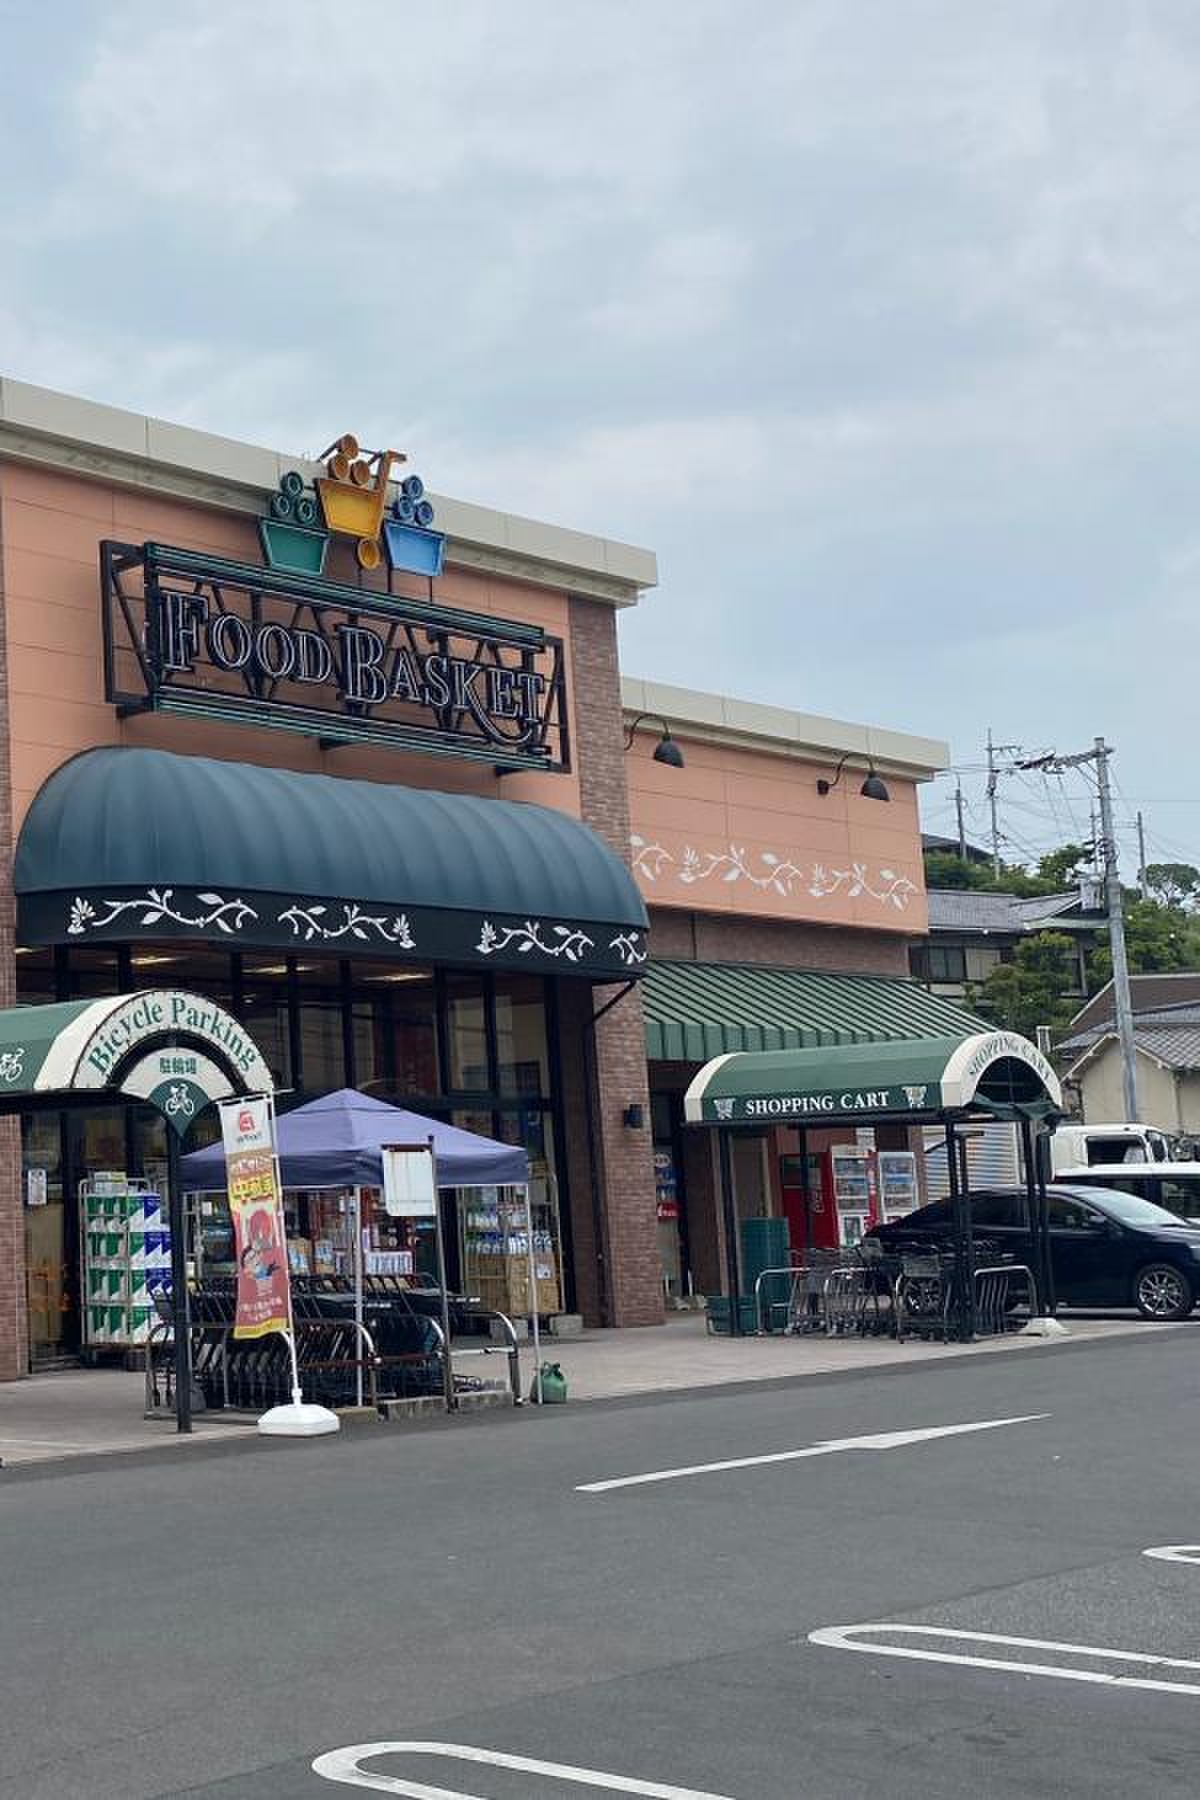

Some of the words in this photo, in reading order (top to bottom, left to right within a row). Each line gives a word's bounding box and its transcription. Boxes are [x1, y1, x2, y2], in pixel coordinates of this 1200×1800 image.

[159, 588, 337, 684] FOOD
[337, 622, 546, 746] BASKET
[88, 998, 163, 1075] Bicycle
[171, 997, 257, 1073] Parking
[159, 1056, 198, 1075] 駐輪場
[745, 1095, 834, 1117] SHOPPING
[840, 1090, 891, 1111] CART
